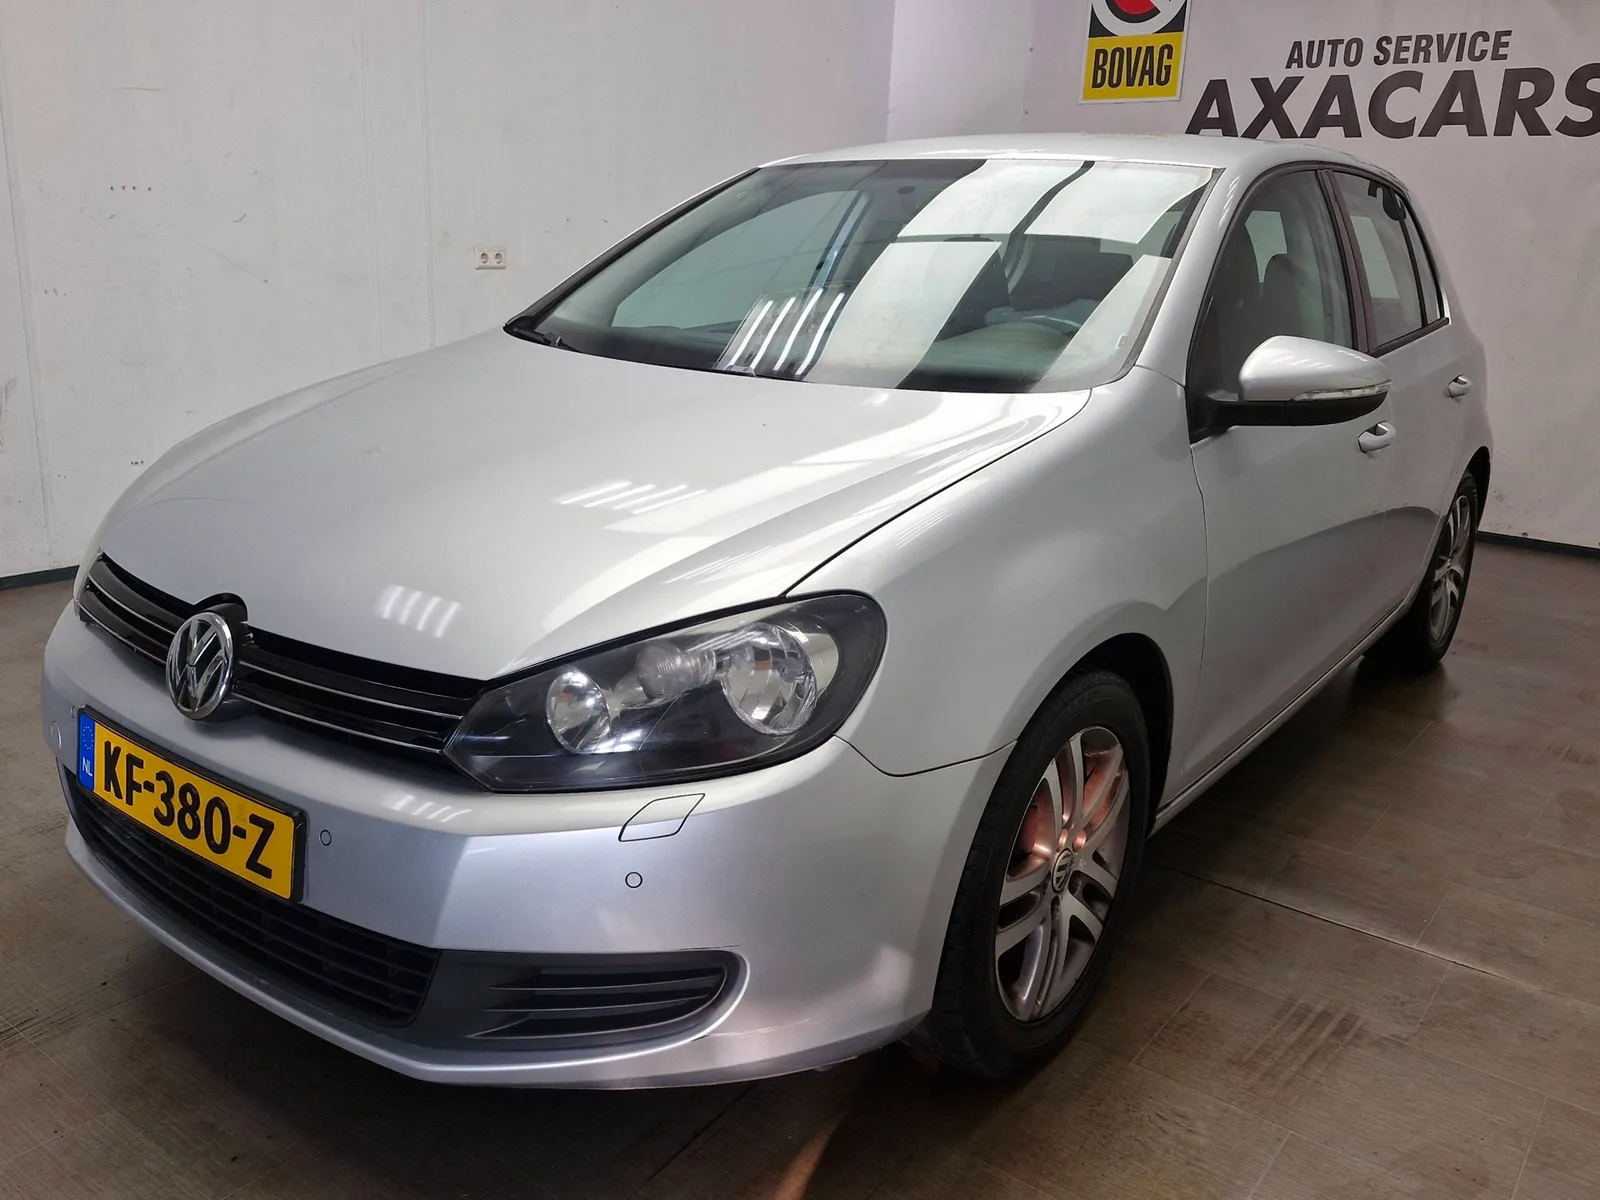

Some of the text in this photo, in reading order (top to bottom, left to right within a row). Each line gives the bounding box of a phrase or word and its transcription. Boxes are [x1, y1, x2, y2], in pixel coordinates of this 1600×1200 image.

[1091, 43, 1174, 89] BOVAG
[1285, 30, 1512, 69] AUTO SERVICE
[1185, 63, 1600, 139] AXACARS
[82, 756, 93, 777] NL
[103, 740, 275, 880] KF-380-Z
